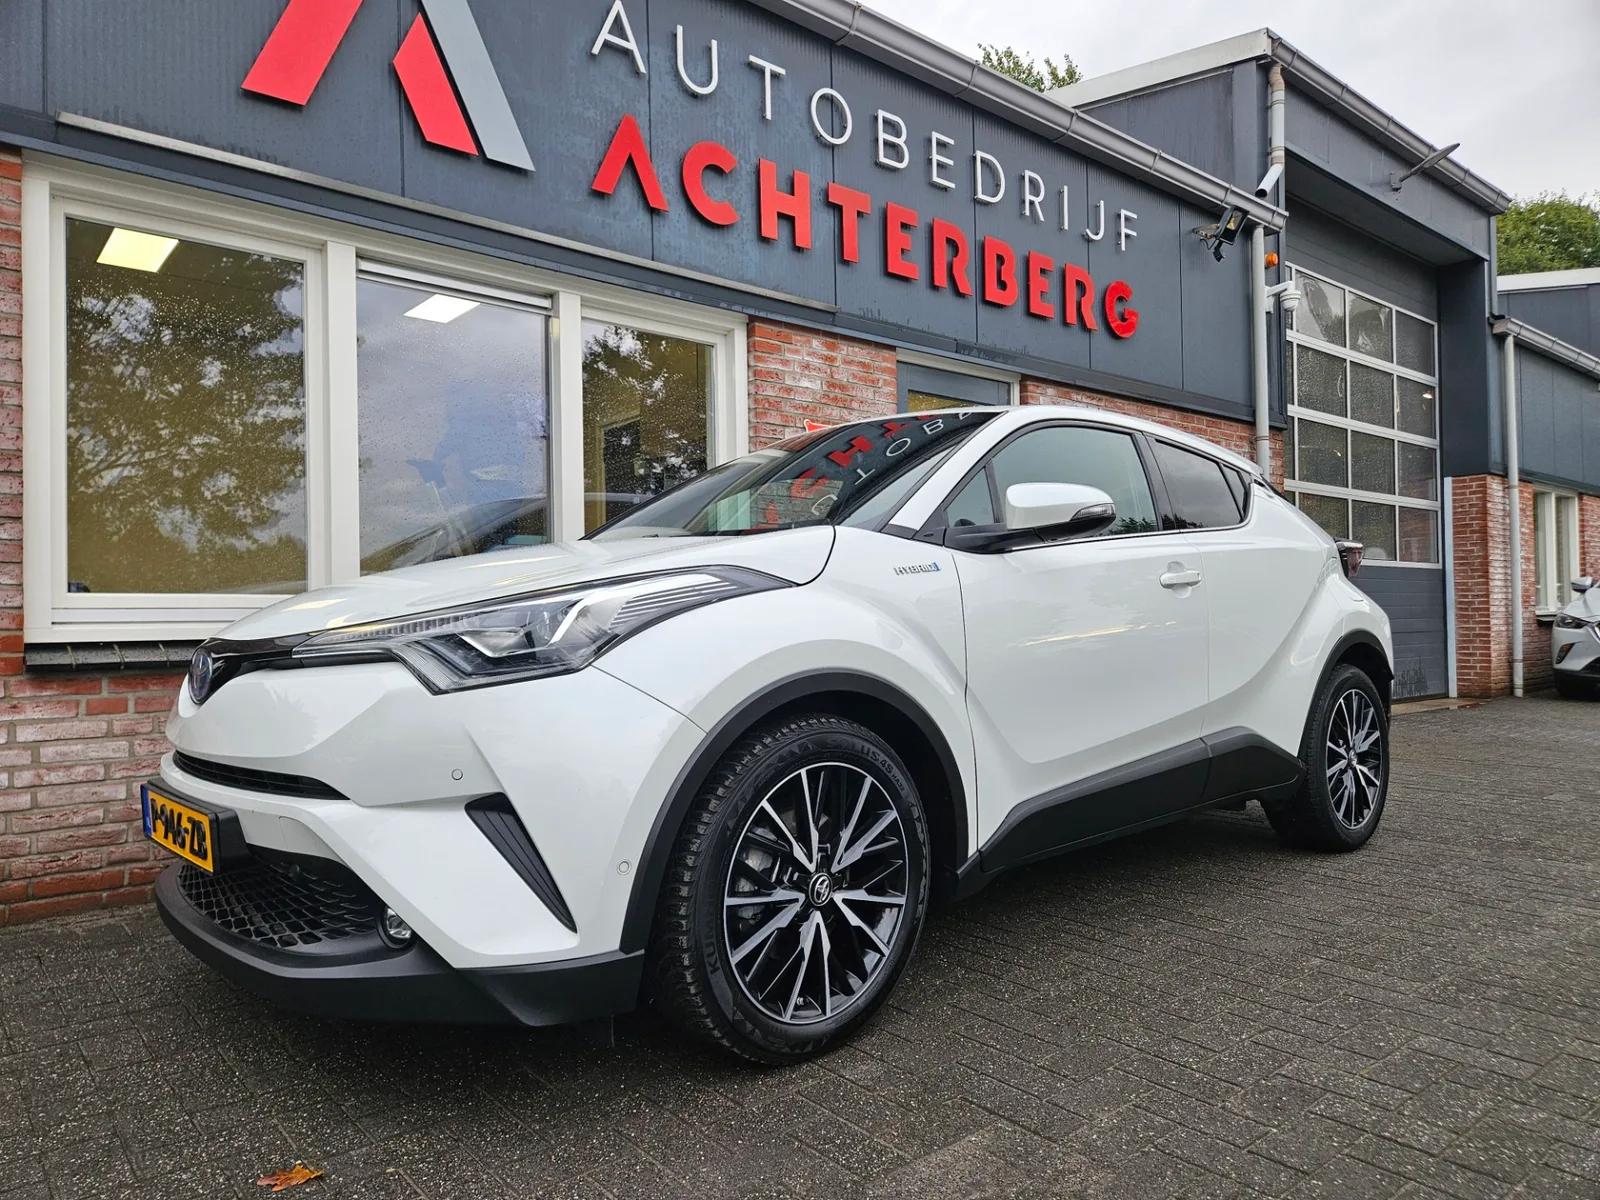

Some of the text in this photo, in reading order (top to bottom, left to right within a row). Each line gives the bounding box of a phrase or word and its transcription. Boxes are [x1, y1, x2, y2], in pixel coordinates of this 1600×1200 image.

[591, 0, 1138, 251] AUTOBEDRIJF
[592, 113, 1139, 339] ACHTERBERG
[893, 562, 937, 576] HYBRID
